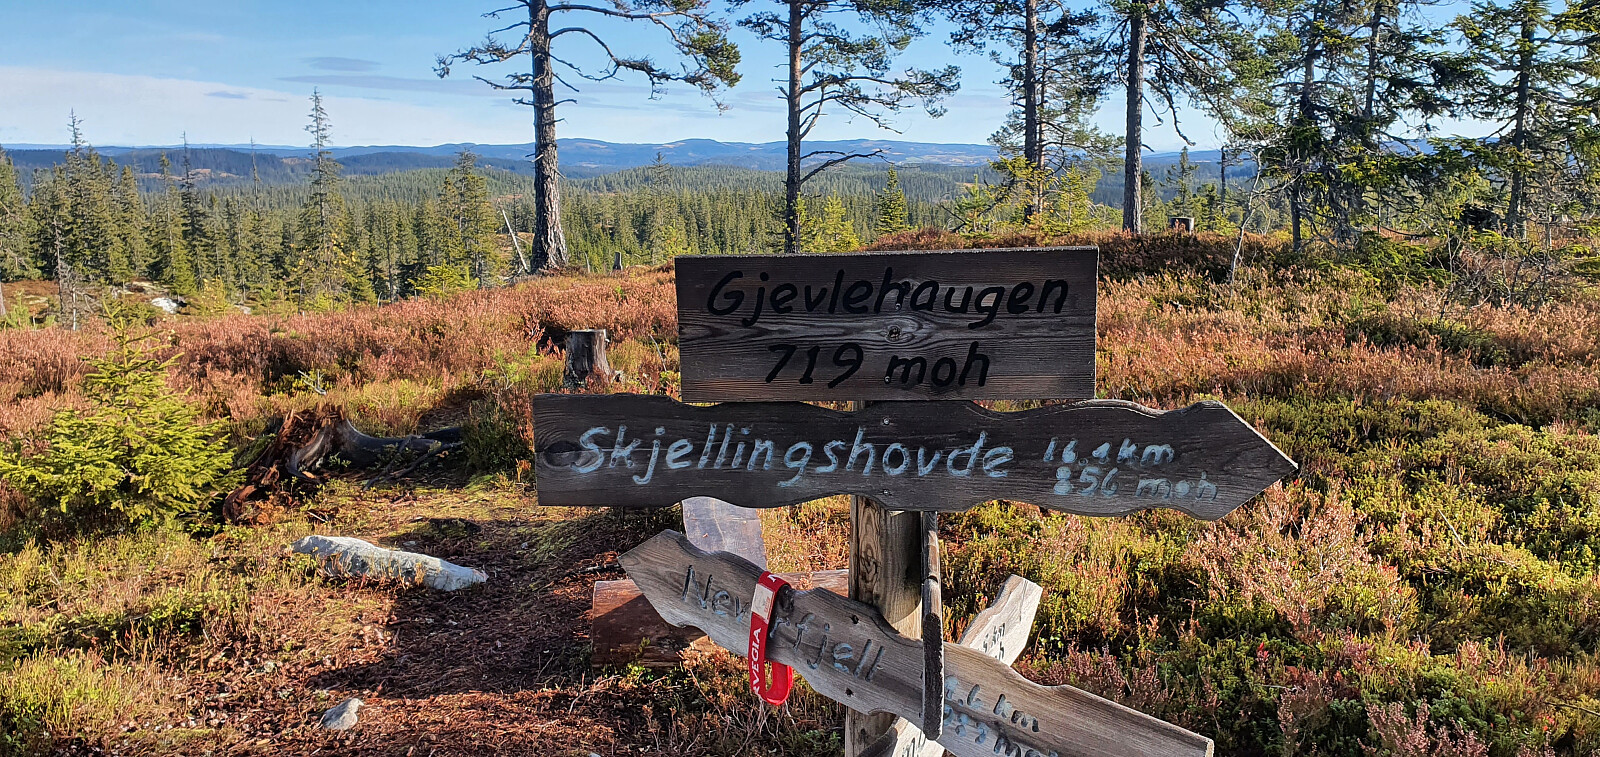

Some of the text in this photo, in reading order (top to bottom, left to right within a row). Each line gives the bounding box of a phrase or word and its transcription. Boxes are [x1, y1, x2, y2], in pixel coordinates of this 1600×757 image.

[706, 266, 1070, 330] Gjevlehaugen
[765, 340, 991, 389] 719 moh
[568, 423, 1015, 487] Skjellingshovde
[1053, 466, 1219, 502] 856 moh
[681, 564, 886, 683] Nevrfjell
[992, 693, 1041, 733] km
